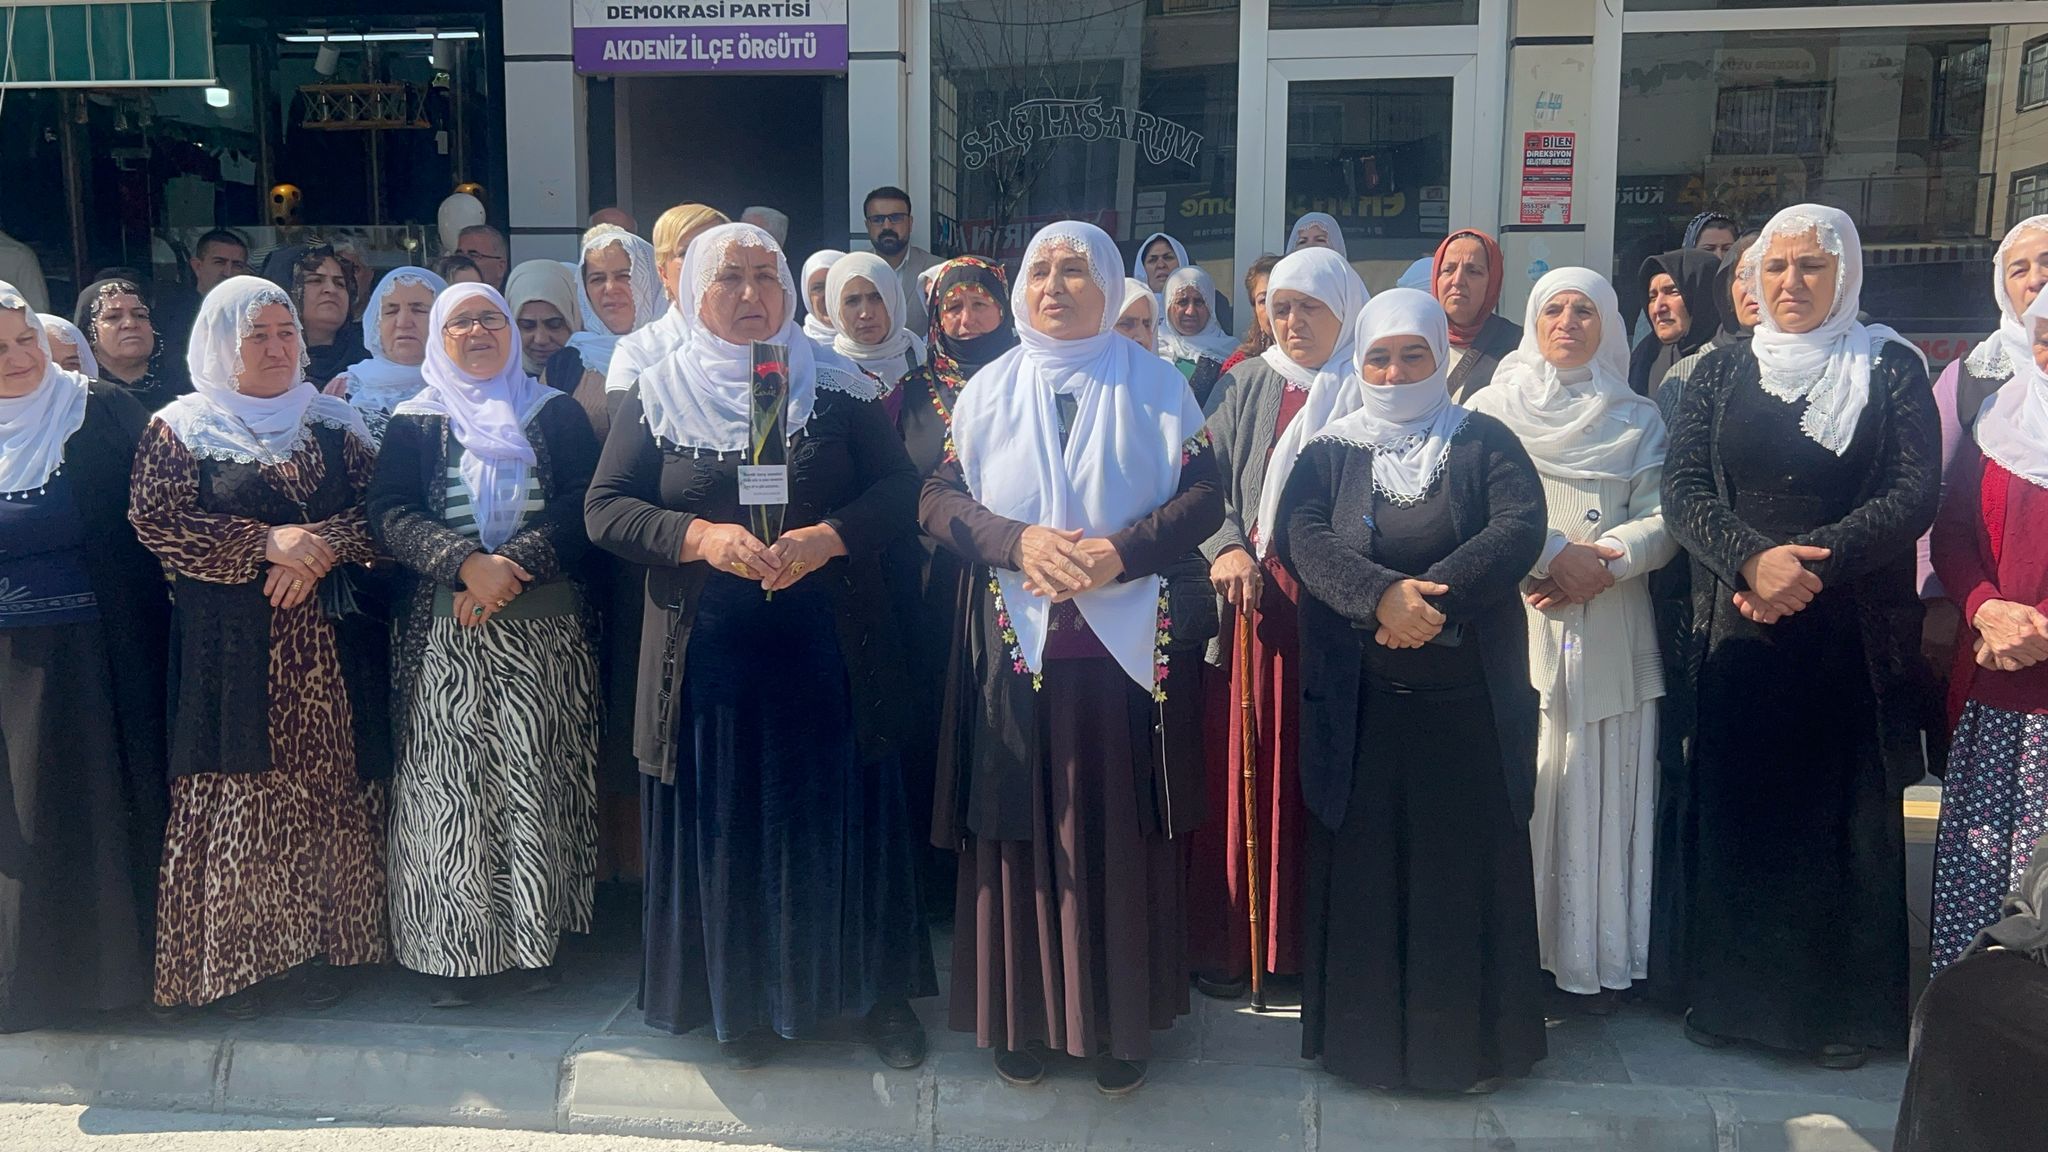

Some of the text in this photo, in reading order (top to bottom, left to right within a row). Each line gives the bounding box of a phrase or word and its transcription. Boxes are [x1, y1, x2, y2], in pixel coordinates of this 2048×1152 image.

[607, 0, 811, 20] DEMOKRASİ PARTİSİ
[603, 32, 816, 64] AKDENİZ İLÇE ÖRGÜTÜ
[961, 107, 1034, 170] SAÇ
[1542, 136, 1573, 148] BİLEN
[1526, 150, 1572, 158] DİREKSİYON
